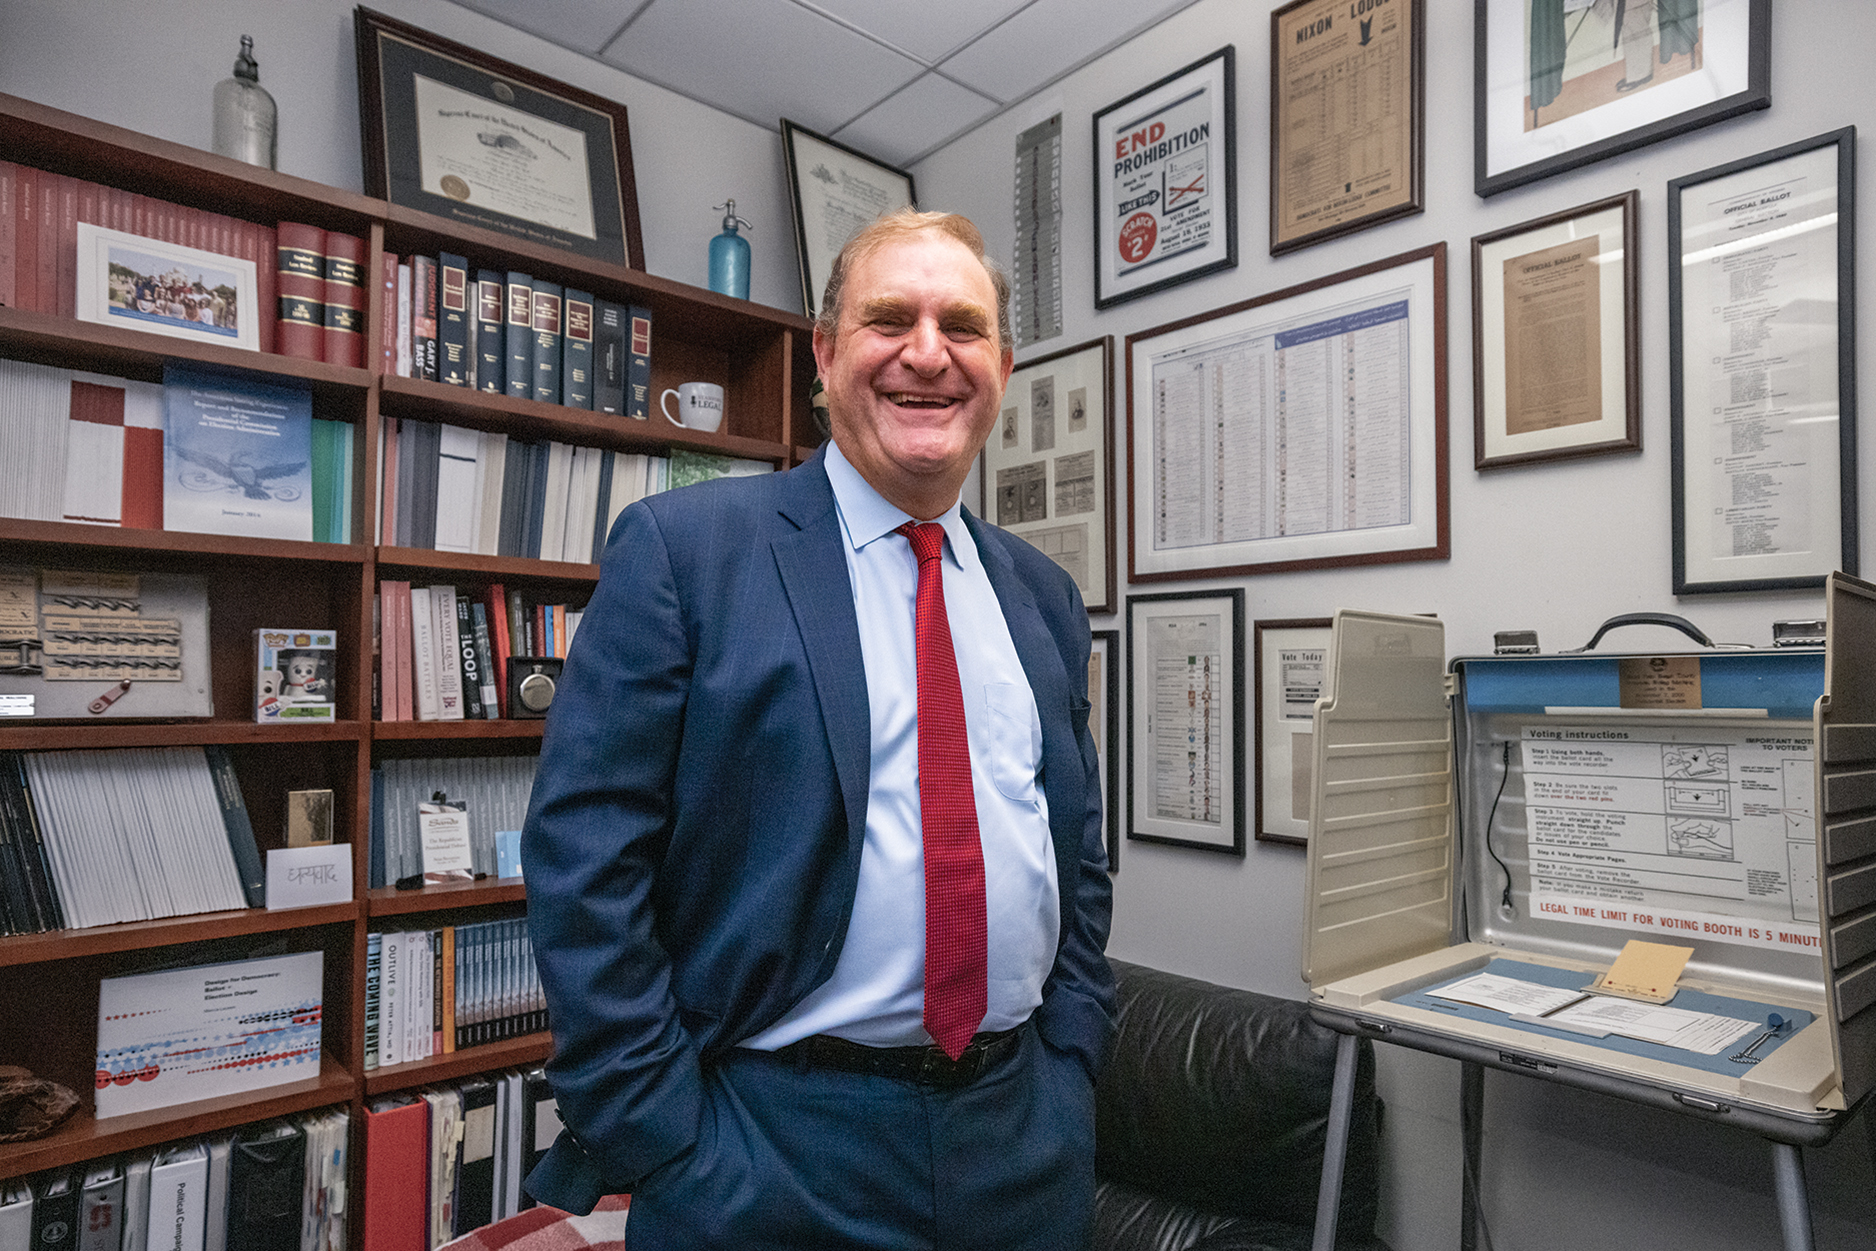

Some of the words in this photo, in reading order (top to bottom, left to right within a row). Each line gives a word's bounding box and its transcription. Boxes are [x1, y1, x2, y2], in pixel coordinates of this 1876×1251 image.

[1296, 14, 1332, 44] NIXON
[1350, 0, 1390, 19] LOD
[1114, 122, 1210, 179] PROHIBITION
[1115, 121, 1166, 160] END
[1120, 201, 1137, 212] LIKE
[1139, 192, 1157, 207] THIS
[1170, 212, 1184, 221] VOTE
[1188, 206, 1200, 214] FOR
[1724, 201, 1757, 215] OFFICIAL
[1760, 191, 1791, 205] BALLOT
[1122, 216, 1154, 238] SCRATCH
[1161, 232, 1180, 244] August
[1194, 220, 1211, 232] 1933
[300, 262, 317, 272] Review
[1522, 261, 1552, 274] OFFICIAL
[1554, 253, 1582, 266] BALLOT
[428, 264, 436, 318] JUDGMENT
[415, 344, 425, 368] BASS
[427, 340, 436, 364] GARY
[425, 364, 435, 375] J.
[194, 400, 216, 409] Report
[218, 404, 230, 412] and
[230, 406, 286, 420] Recommendations
[202, 413, 238, 425] Presidential
[240, 420, 278, 430] Commission
[209, 421, 234, 430] Election
[236, 425, 280, 436] Administration
[442, 593, 450, 619] EVERY
[420, 624, 430, 659] BALLOT
[444, 621, 452, 642] VOTE
[446, 644, 454, 671] EQUAL
[461, 640, 478, 681] LOOP
[1282, 653, 1297, 661] Vote
[1302, 652, 1322, 662] Today
[423, 661, 432, 700] BATTLES
[264, 703, 279, 712] BILL
[1530, 730, 1562, 740] Voting
[1565, 730, 1629, 739] instructions
[1540, 902, 1568, 914] LEGAL
[1573, 906, 1596, 918] TIME
[1601, 910, 1628, 922] LIMIT
[1633, 914, 1654, 925] FOR
[1660, 916, 1699, 932] VOTING
[1704, 922, 1742, 937] BOOTH
[1749, 928, 1760, 939] IS
[1766, 930, 1773, 941] 5
[1779, 932, 1822, 948] MINUT
[368, 952, 380, 973] THE
[387, 944, 397, 985] OUTLIVE
[204, 992, 233, 1000] Election
[367, 976, 380, 1020] COMING
[366, 1022, 379, 1055] WAVE
[386, 1039, 393, 1050] MD
[176, 1182, 186, 1216] Political
